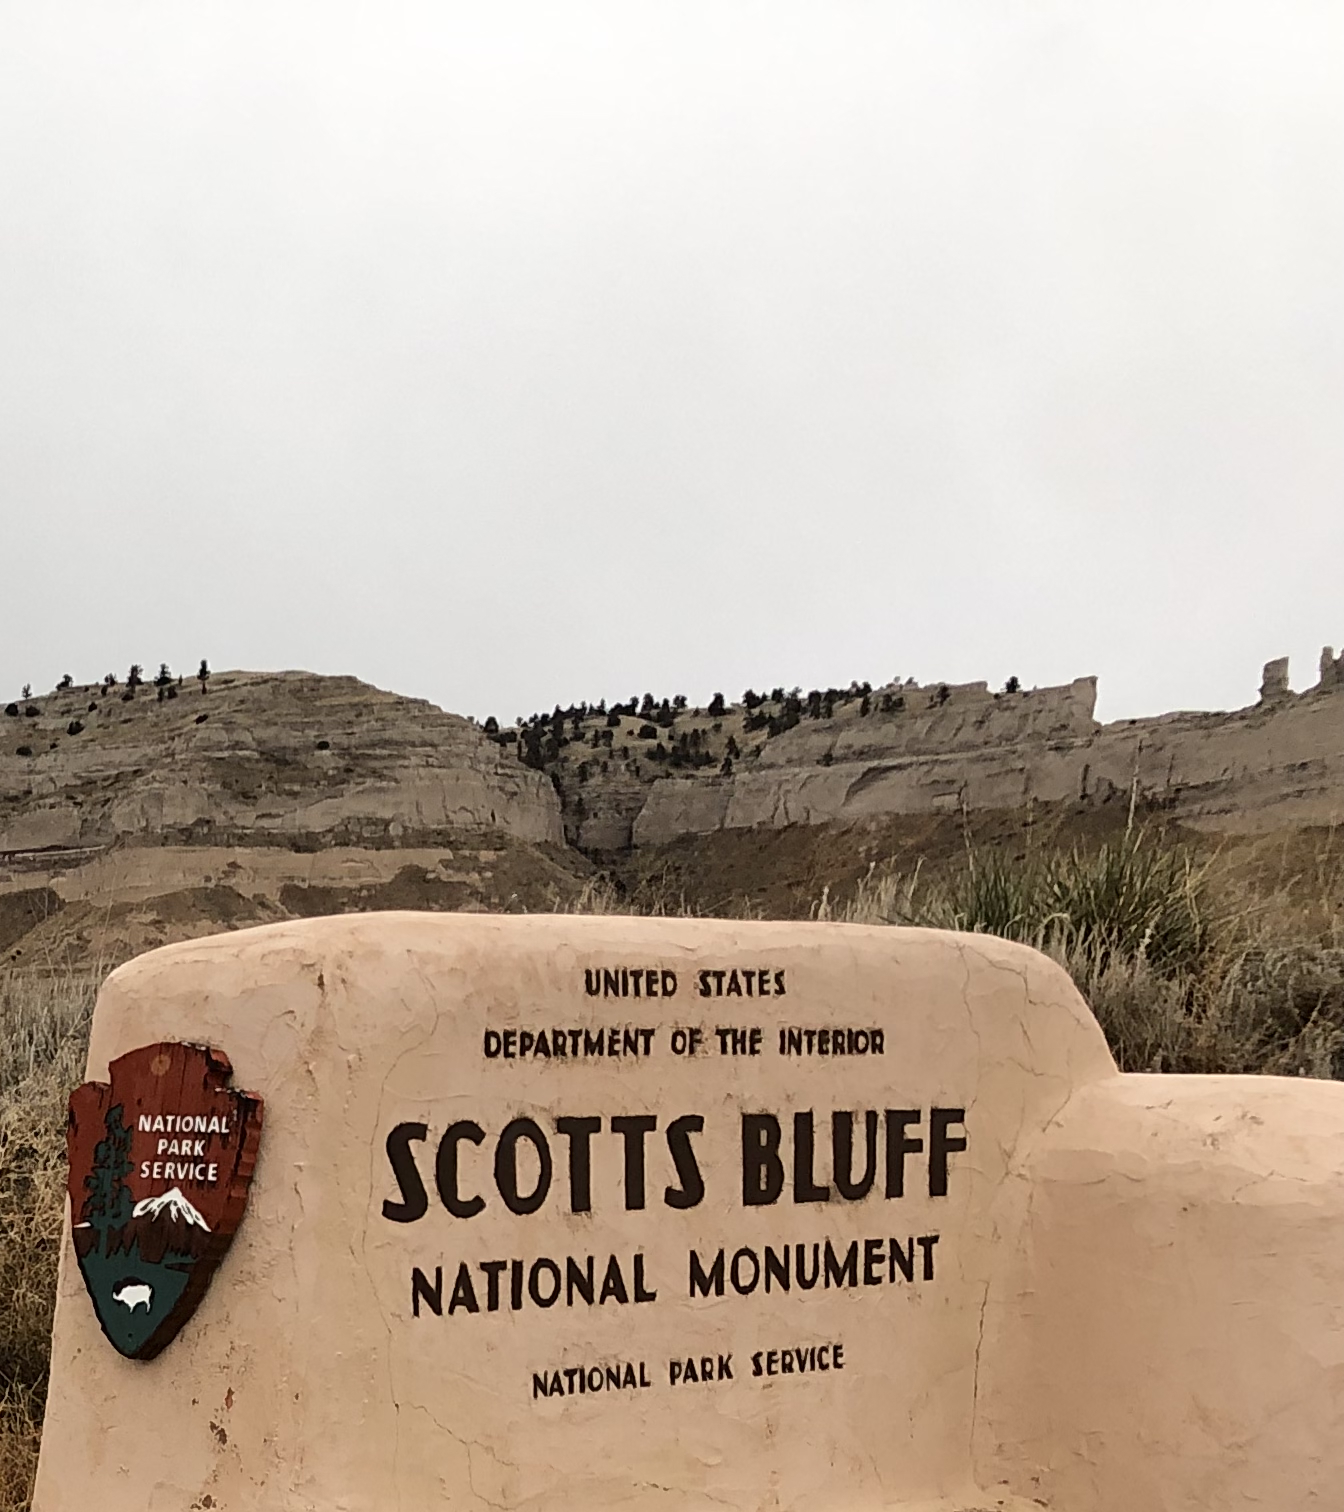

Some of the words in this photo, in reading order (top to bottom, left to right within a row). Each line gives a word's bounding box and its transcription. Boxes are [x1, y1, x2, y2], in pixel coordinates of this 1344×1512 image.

[584, 968, 677, 998] UNITED
[698, 968, 786, 997] STATES
[483, 1028, 656, 1058] DEPARTMENT
[670, 1028, 703, 1055] OF
[715, 1028, 762, 1056] THE
[779, 1028, 885, 1056] INTERIOR
[138, 1114, 230, 1133] NATIONAL
[157, 1138, 206, 1156] PARK
[140, 1161, 218, 1181] SERVICE
[381, 1114, 705, 1223] SCOTTS
[740, 1108, 967, 1207] BLUFF
[411, 1252, 657, 1318] NATIONAL
[689, 1234, 940, 1299] MONUMENT
[533, 1361, 651, 1399] NATIONAL
[669, 1353, 734, 1385] PARK
[751, 1344, 845, 1377] SERVICE
